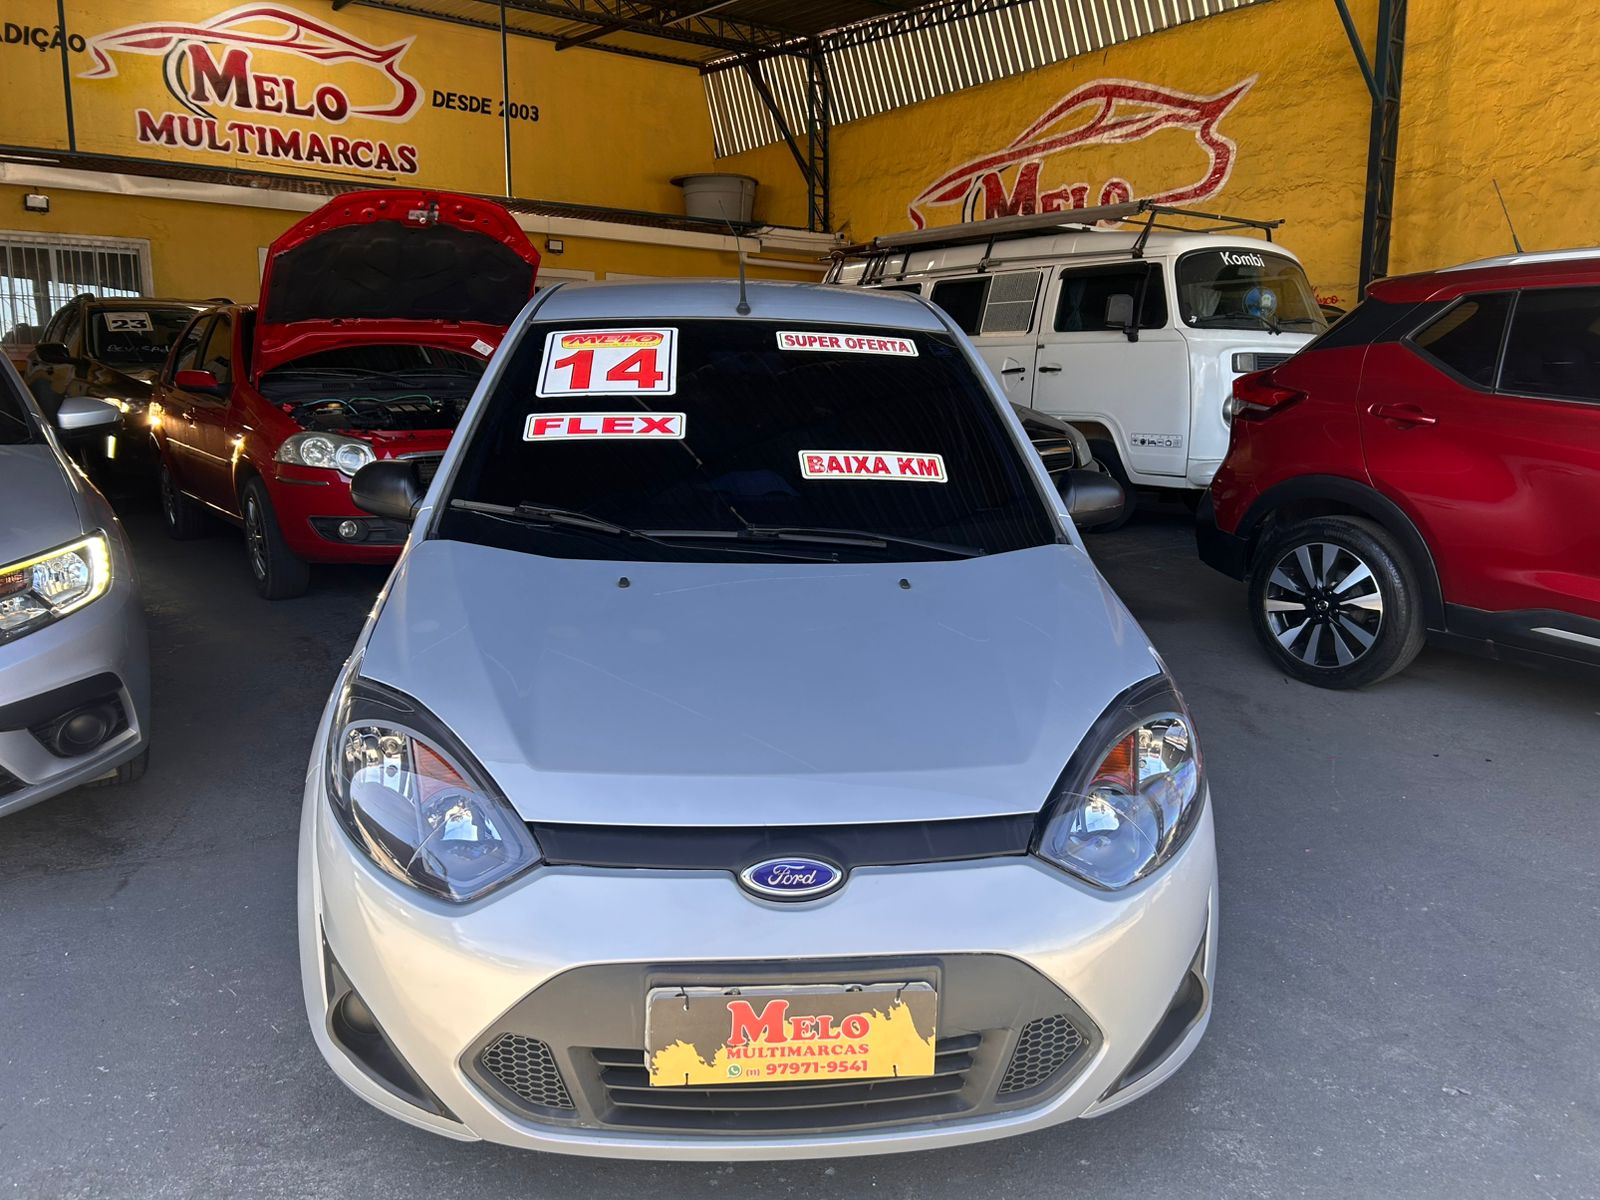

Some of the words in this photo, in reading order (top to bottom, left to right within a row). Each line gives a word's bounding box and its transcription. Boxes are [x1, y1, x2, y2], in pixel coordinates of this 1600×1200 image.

[0, 22, 86, 53] DIÇÃO
[187, 43, 349, 121] MELO
[432, 90, 492, 115] DESDE
[498, 100, 540, 122] 2003
[136, 110, 418, 174] MULTIMARCAS
[1220, 251, 1265, 267] Kombi
[112, 319, 147, 329] 23
[568, 334, 660, 345] MELO
[784, 334, 842, 349] SUPER
[844, 337, 911, 353] OFERTA
[554, 348, 664, 390] 14
[532, 416, 676, 435] FLEX
[806, 455, 891, 475] BAIXA
[896, 457, 940, 477] KM
[767, 863, 817, 885] Ford
[726, 999, 870, 1046] MELO
[727, 1043, 869, 1059] MULTIMARCAS
[745, 1068, 761, 1077] (11)
[766, 1060, 868, 1075] 97971-9541
